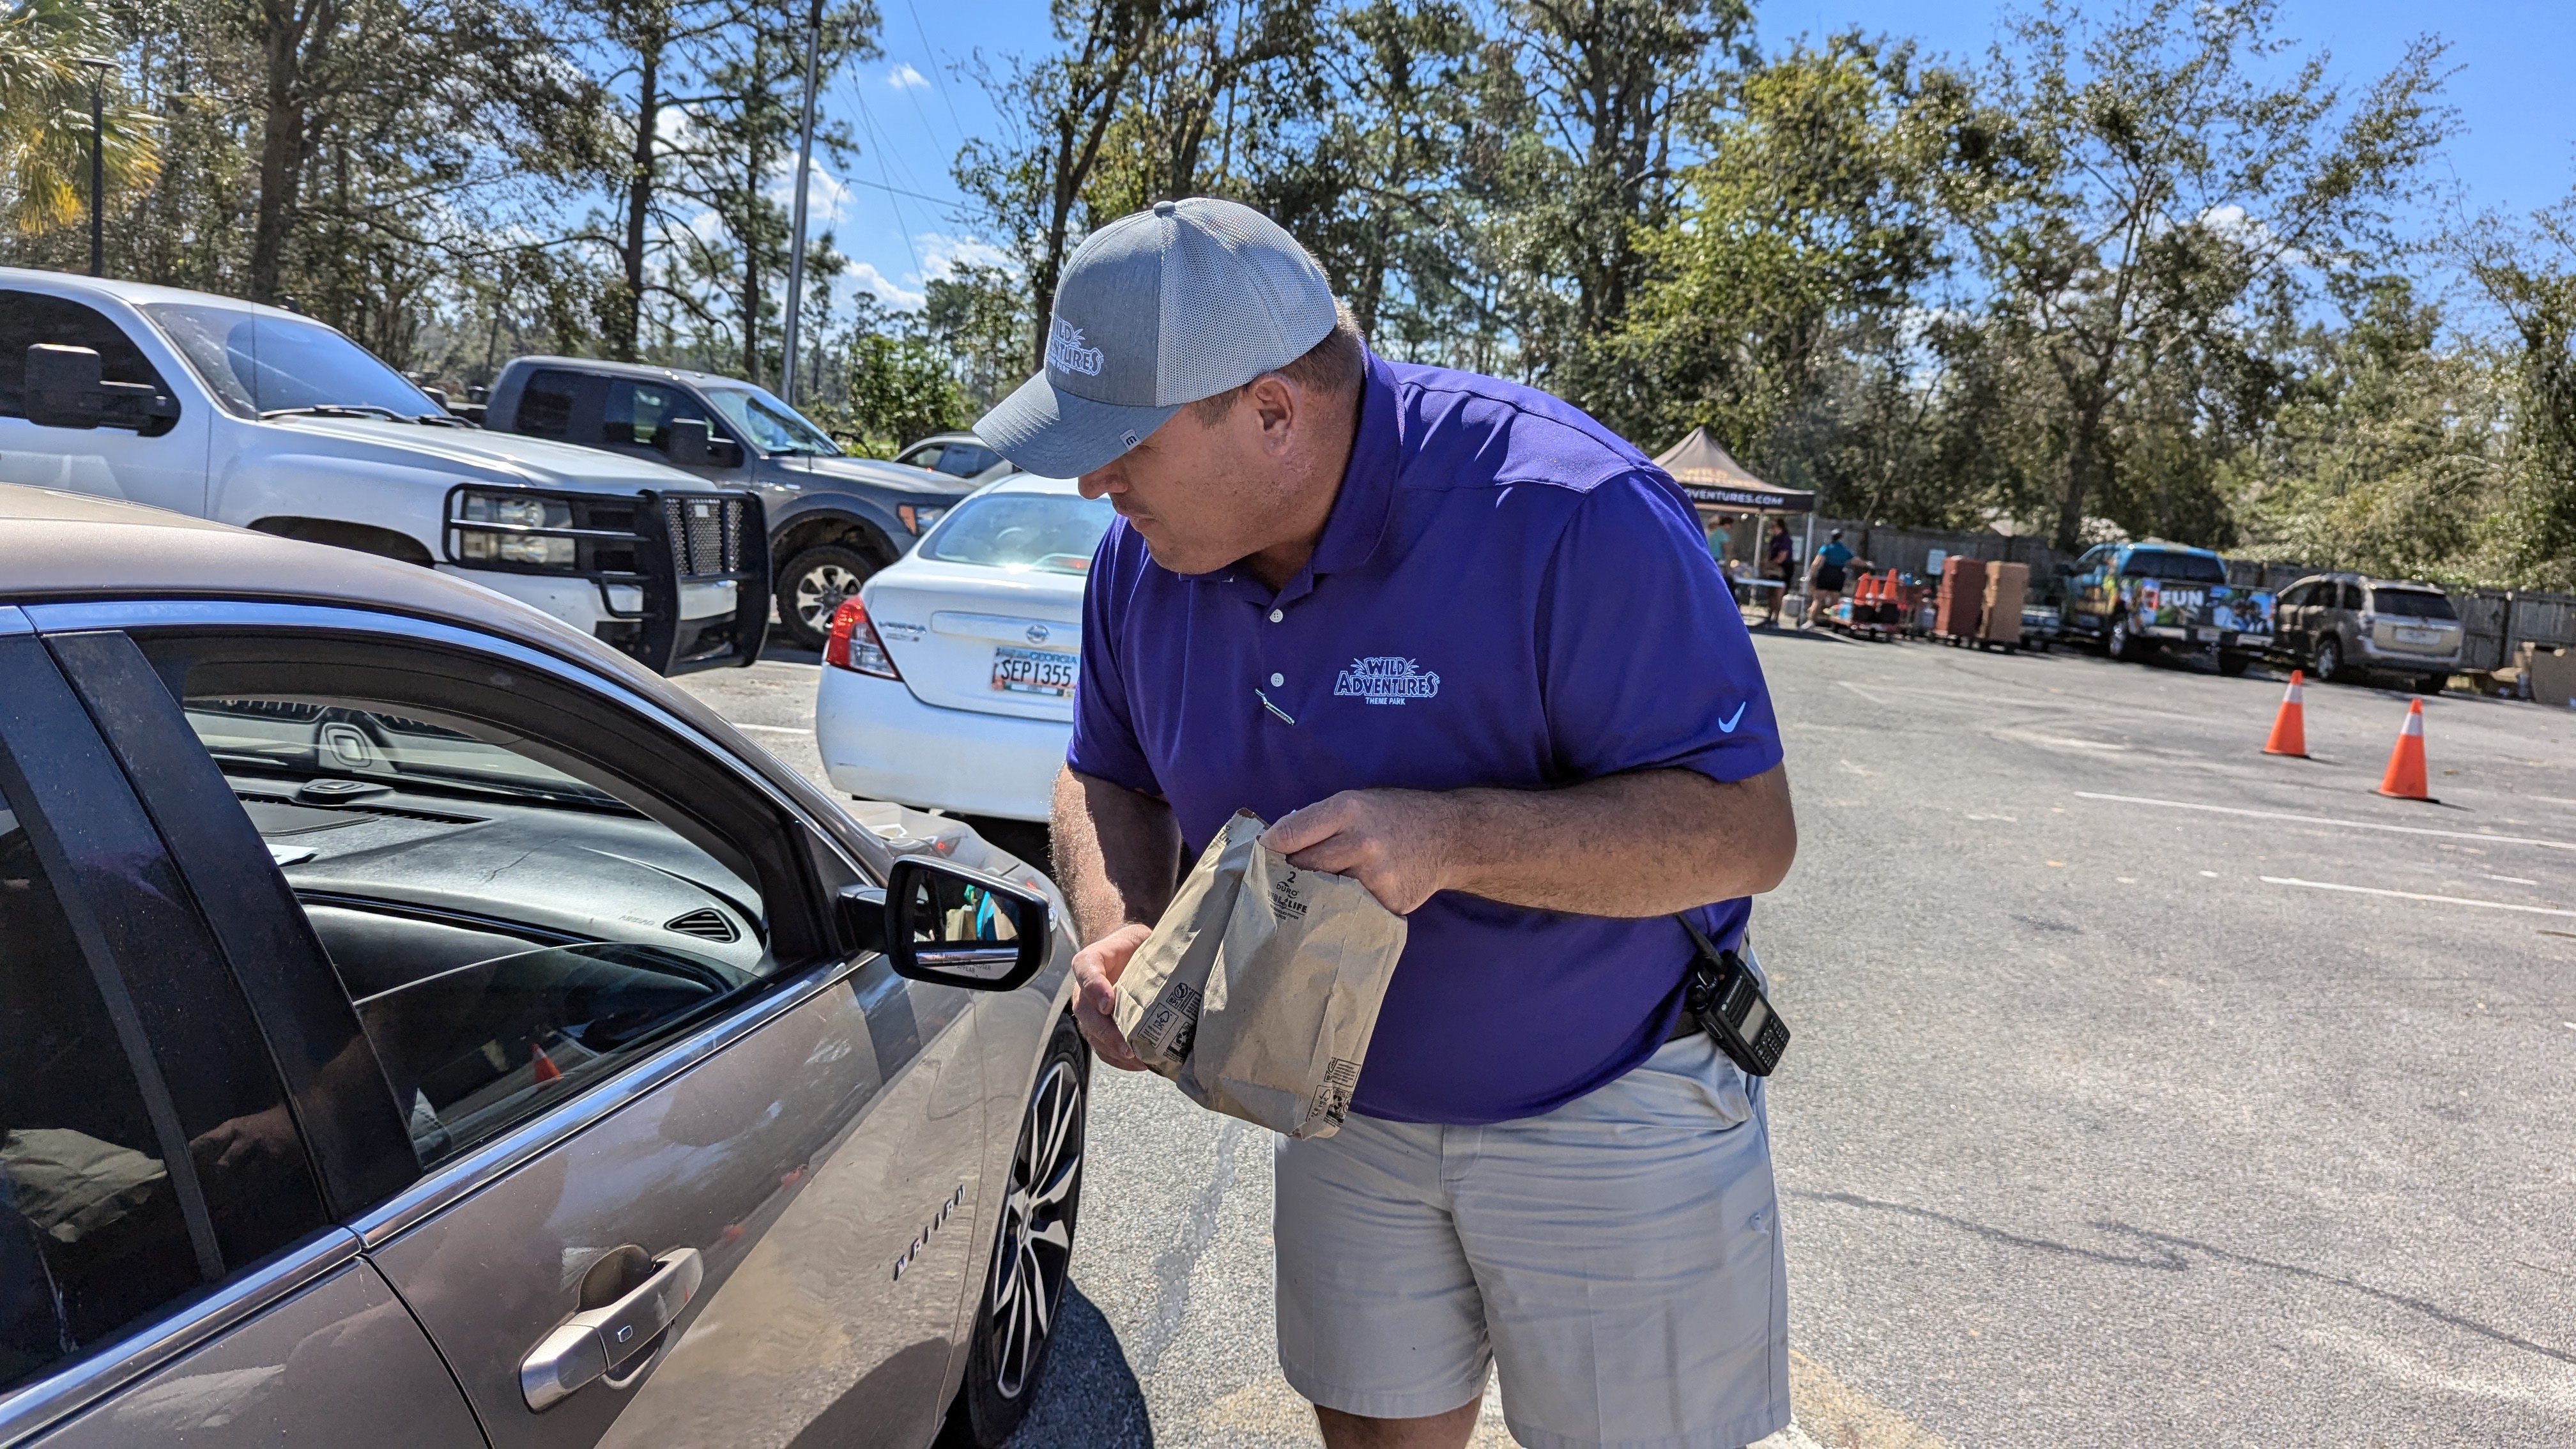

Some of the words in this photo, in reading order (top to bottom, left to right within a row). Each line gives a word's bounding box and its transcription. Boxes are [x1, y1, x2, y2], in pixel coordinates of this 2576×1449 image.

[1055, 315, 1075, 345] ILD
[1057, 362, 1070, 374] PARK
[2159, 590, 2205, 608] FUN
[1029, 651, 1078, 664] GEORGIA
[1001, 659, 1072, 687] SEP1355
[1365, 656, 1407, 677] WILD
[1334, 671, 1439, 698] ADVENTURES
[1365, 696, 1388, 705] THEME
[1388, 697, 1406, 706] PARK
[1287, 871, 1296, 884] 2
[1276, 883, 1298, 896] DURO
[1287, 900, 1308, 914] LIFE
